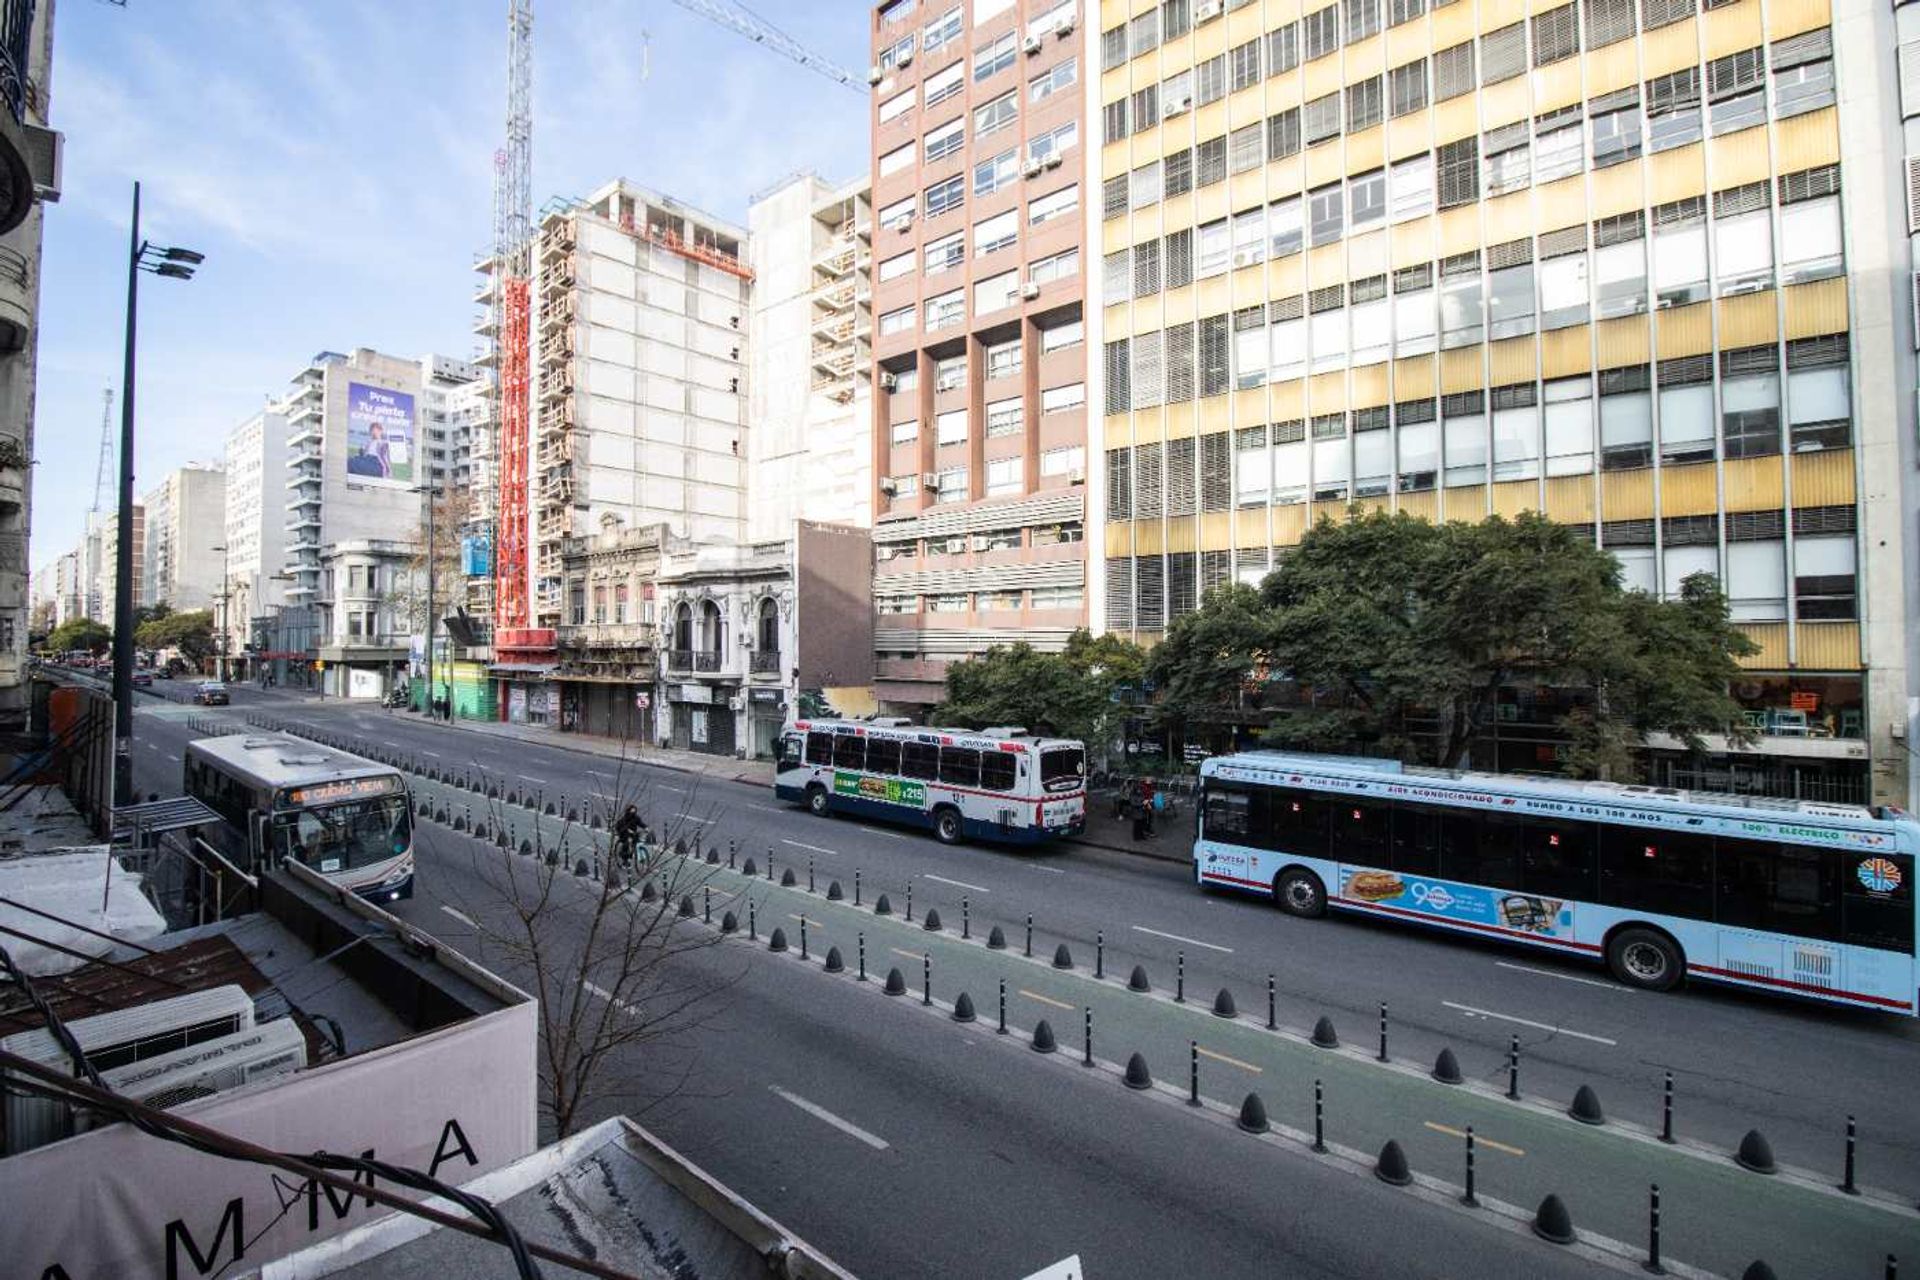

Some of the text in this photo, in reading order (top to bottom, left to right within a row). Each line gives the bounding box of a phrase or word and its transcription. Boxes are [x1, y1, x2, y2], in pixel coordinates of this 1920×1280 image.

[314, 784, 353, 798] CIUDAD
[356, 780, 385, 793] VIEJA
[1387, 786, 1494, 804] AIRE ACONDICIONADO
[1526, 800, 1564, 812] RUMBO
[1567, 805, 1576, 813] A
[1579, 807, 1601, 815] LOS
